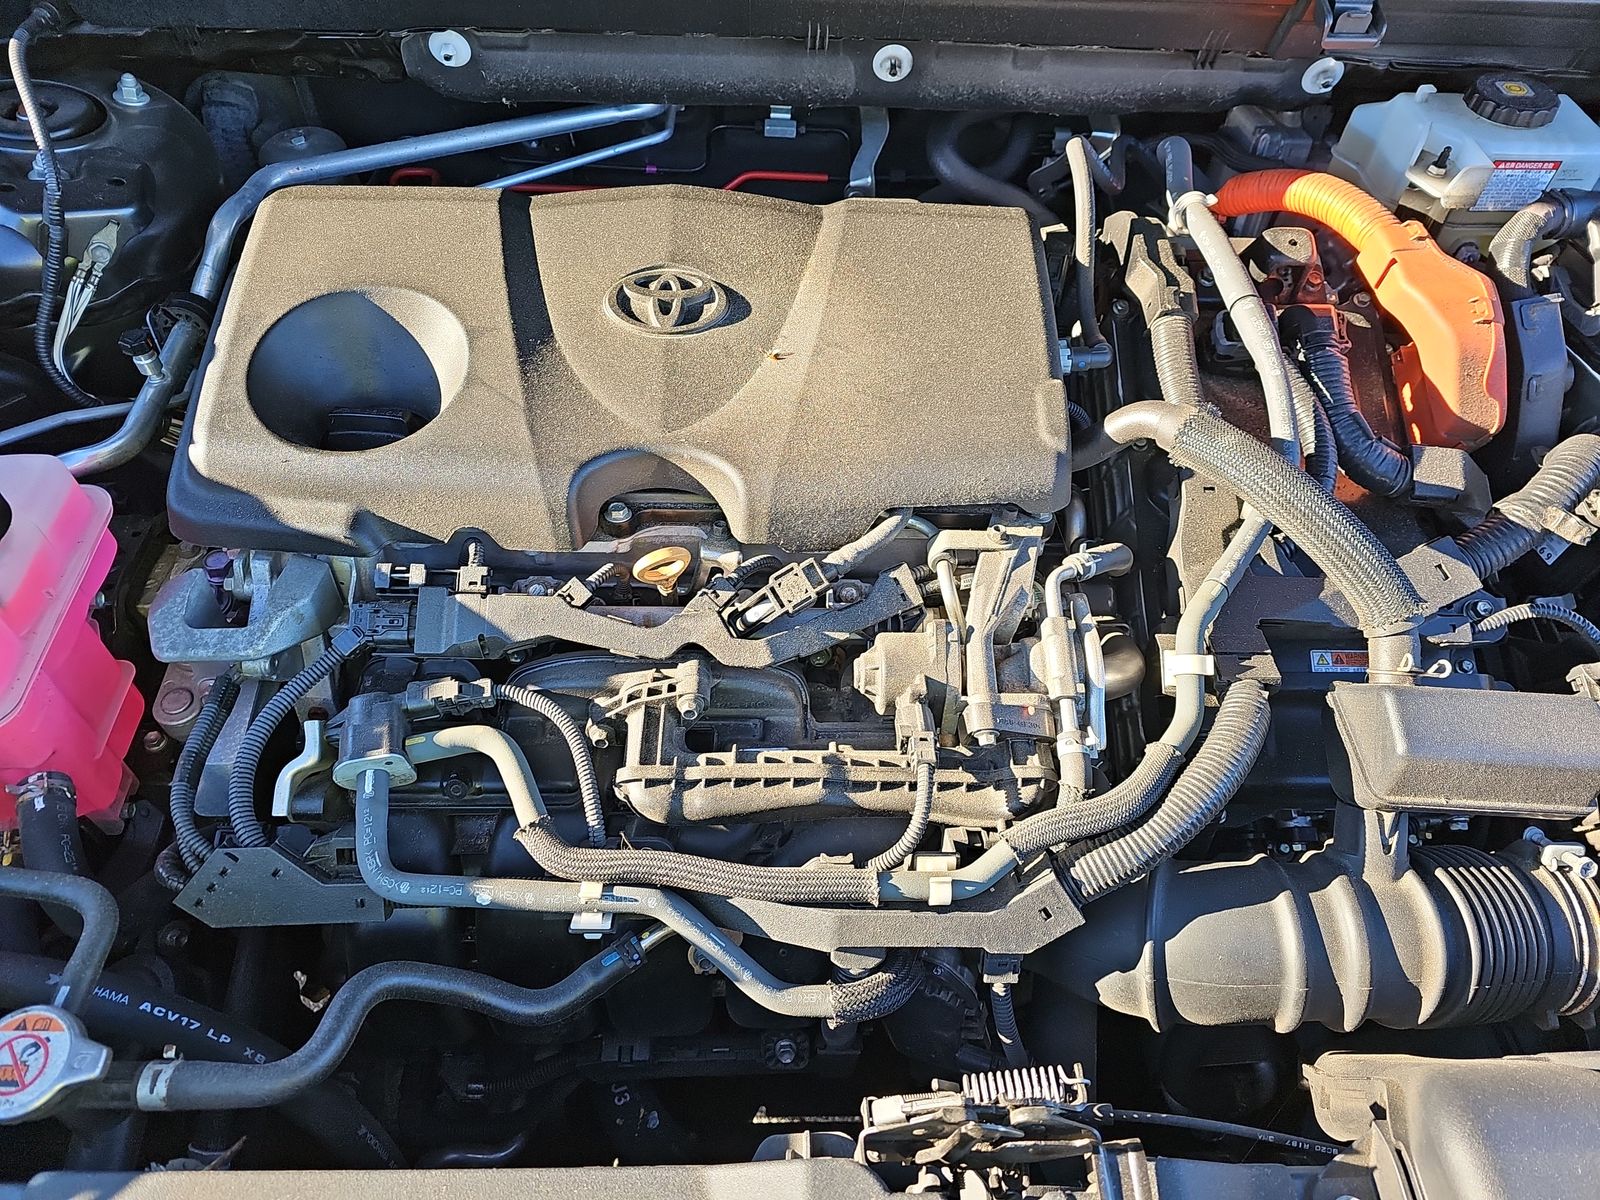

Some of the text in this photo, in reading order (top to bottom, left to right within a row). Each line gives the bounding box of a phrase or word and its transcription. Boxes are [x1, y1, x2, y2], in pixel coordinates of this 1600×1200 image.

[1539, 547, 1553, 560] 69
[92, 985, 130, 1006] HAMA
[139, 1001, 202, 1030] ACV17
[206, 1028, 232, 1045] LP
